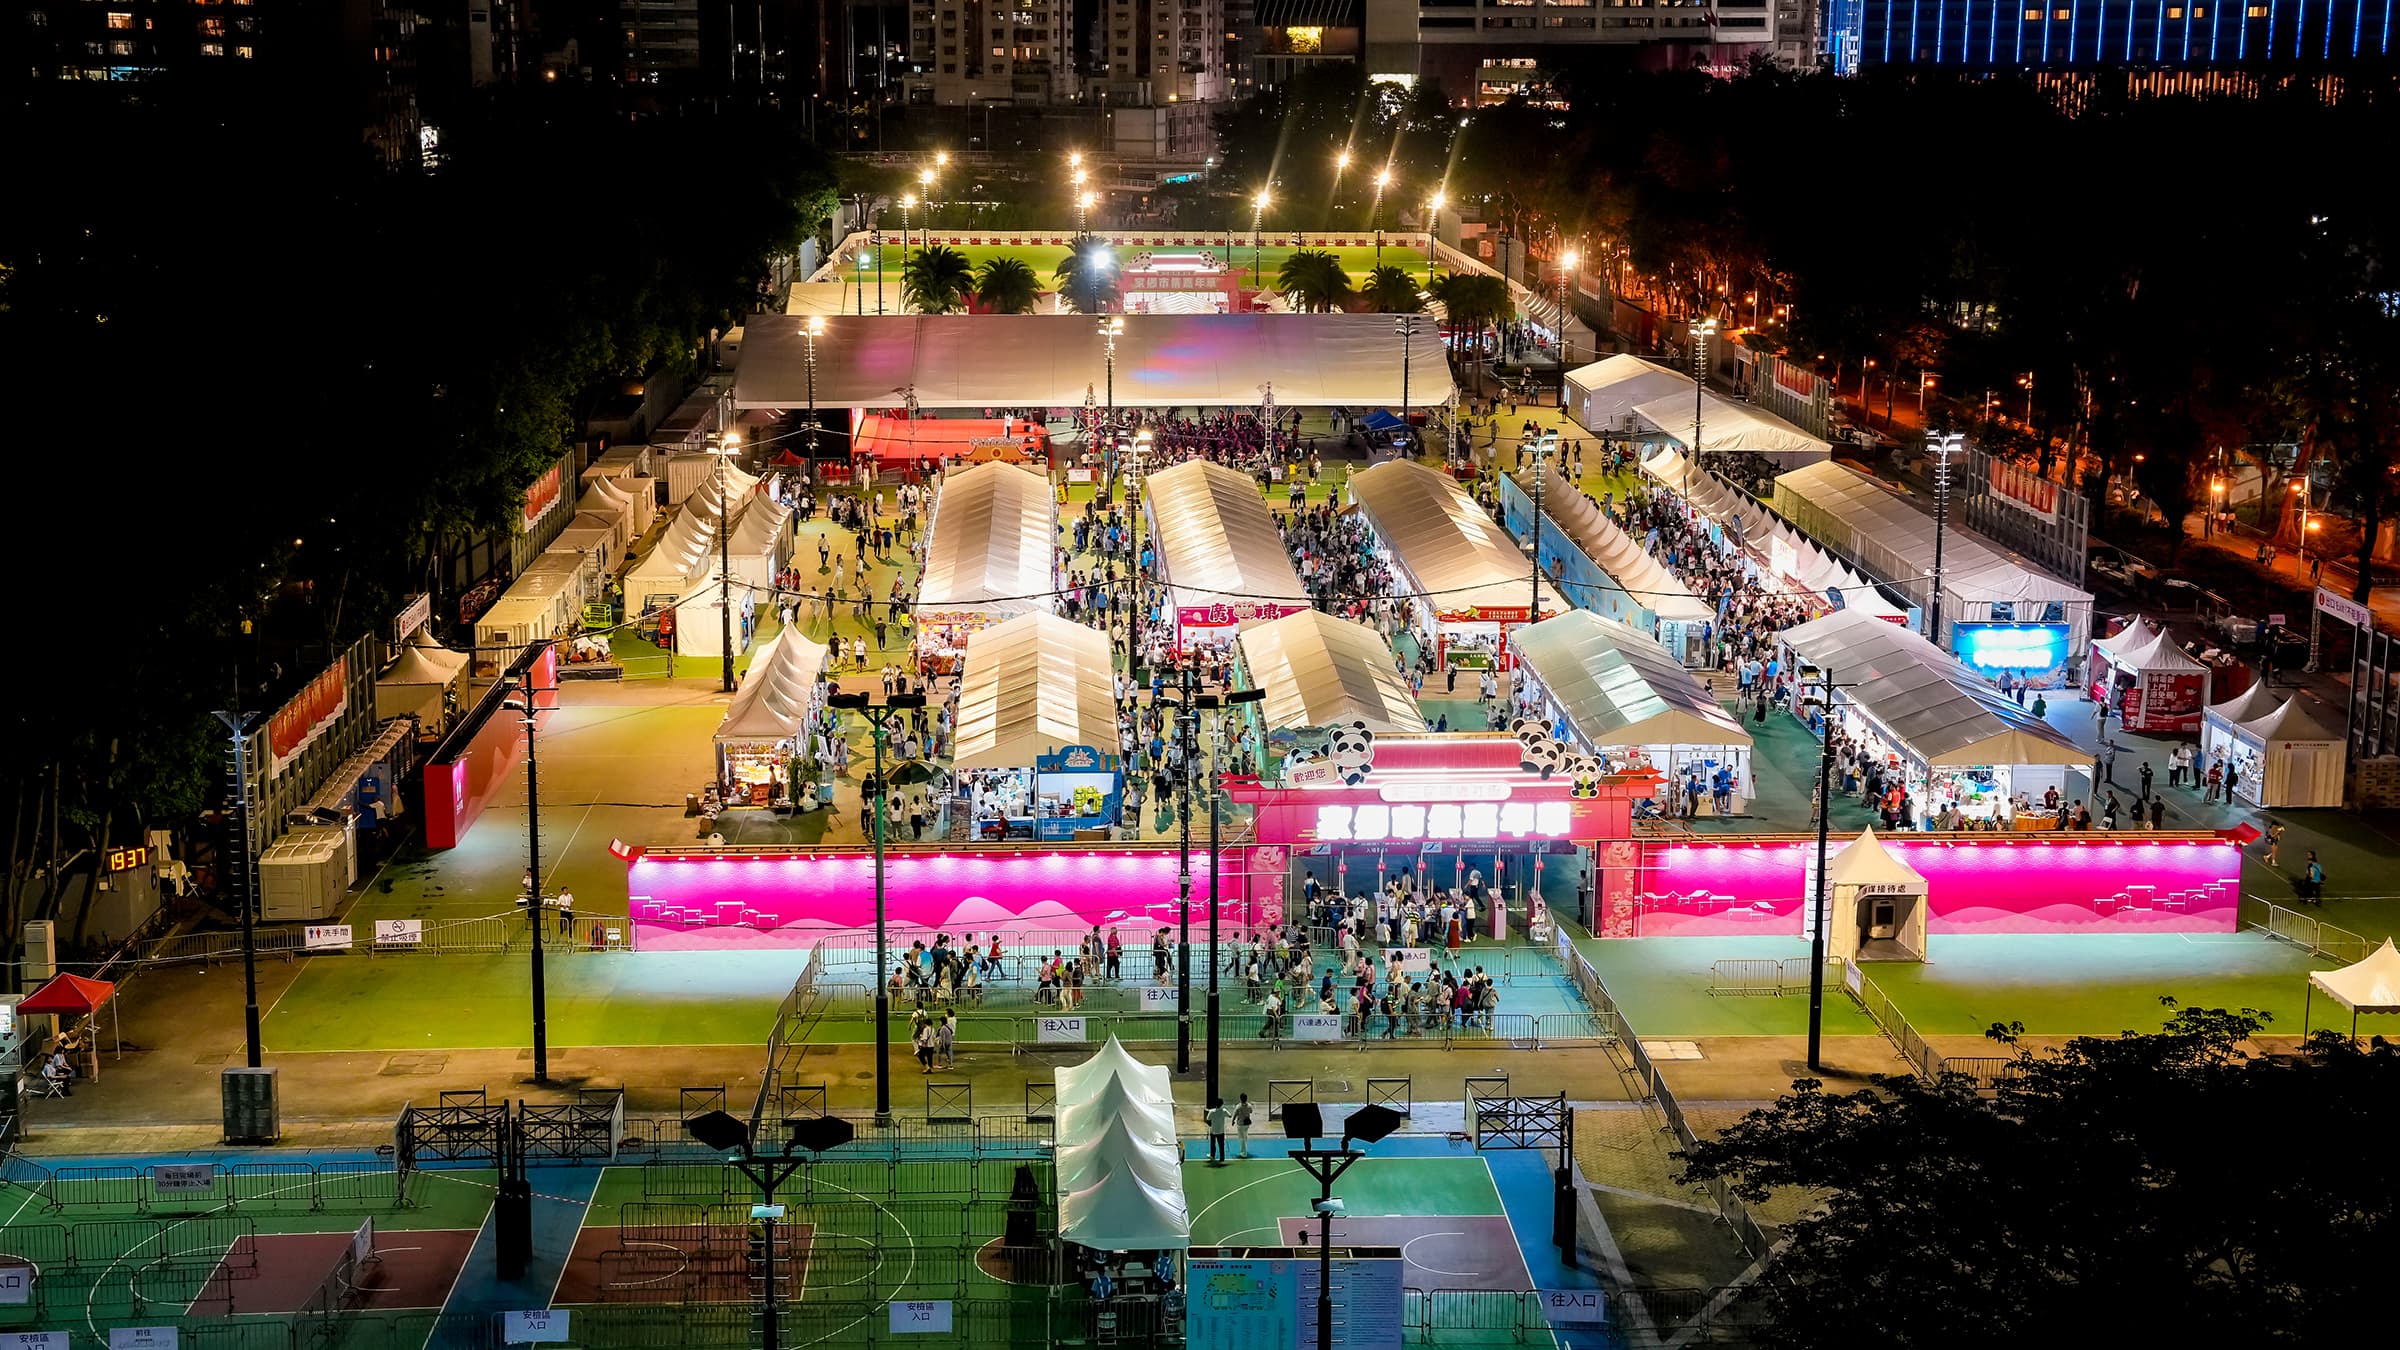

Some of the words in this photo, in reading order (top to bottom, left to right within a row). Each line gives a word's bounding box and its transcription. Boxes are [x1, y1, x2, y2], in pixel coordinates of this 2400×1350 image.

[111, 847, 146, 870] 1937
[322, 928, 349, 937] 洗手間
[1044, 1020, 1080, 1031] 往入口
[1298, 1019, 1338, 1027] 八達通入口
[1551, 1293, 1596, 1307] 往入口
[912, 1312, 930, 1321] 入口
[527, 1321, 546, 1330] 入口
